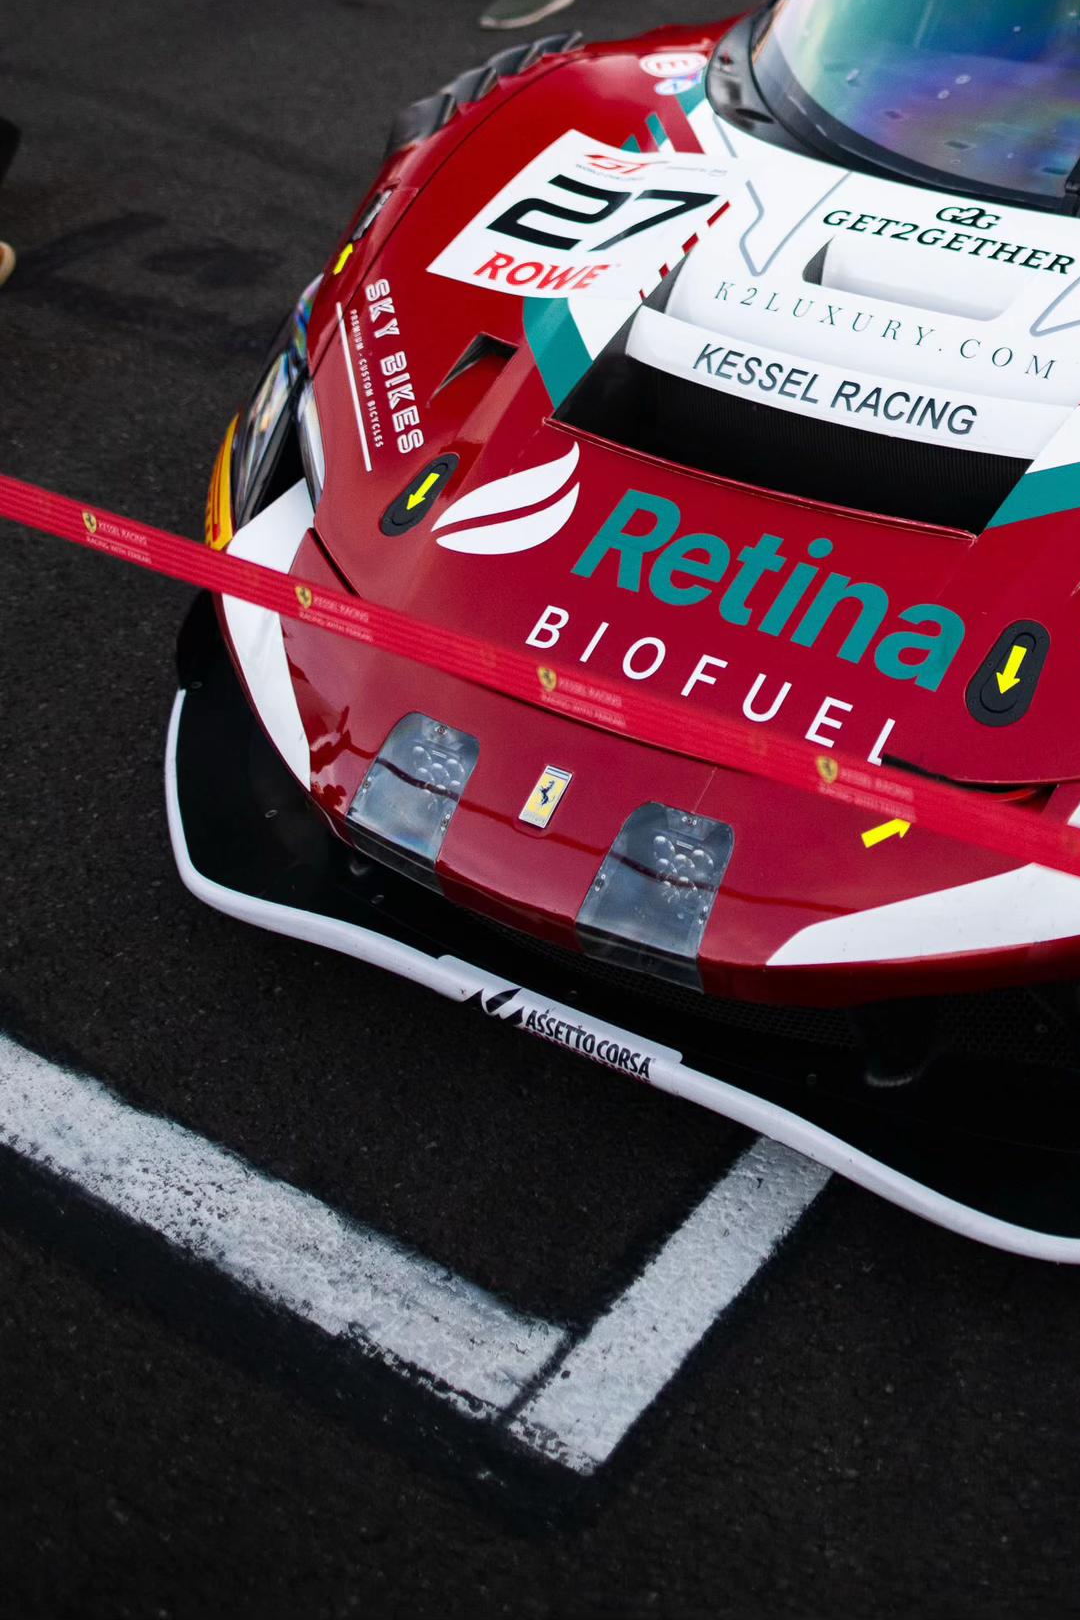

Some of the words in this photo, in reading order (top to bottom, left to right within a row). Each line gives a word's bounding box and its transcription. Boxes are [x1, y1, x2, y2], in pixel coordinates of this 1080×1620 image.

[486, 173, 721, 252] 27
[822, 209, 1077, 276] GET2GETHER
[473, 251, 612, 291] ROWE
[350, 308, 365, 352] PREMIUM
[364, 278, 401, 340] SKY
[714, 281, 1058, 381] K2LUXURY.COM
[357, 358, 375, 398] CUSTOM
[379, 350, 425, 455] BIKES
[692, 342, 820, 404] KESSEL
[829, 379, 979, 436] RACING
[366, 398, 385, 448] BICYCLES
[570, 488, 967, 693] Retina
[524, 605, 897, 767] BIOFUEL
[525, 1008, 595, 1055] ASSETTO
[595, 1039, 651, 1079] CORSA
